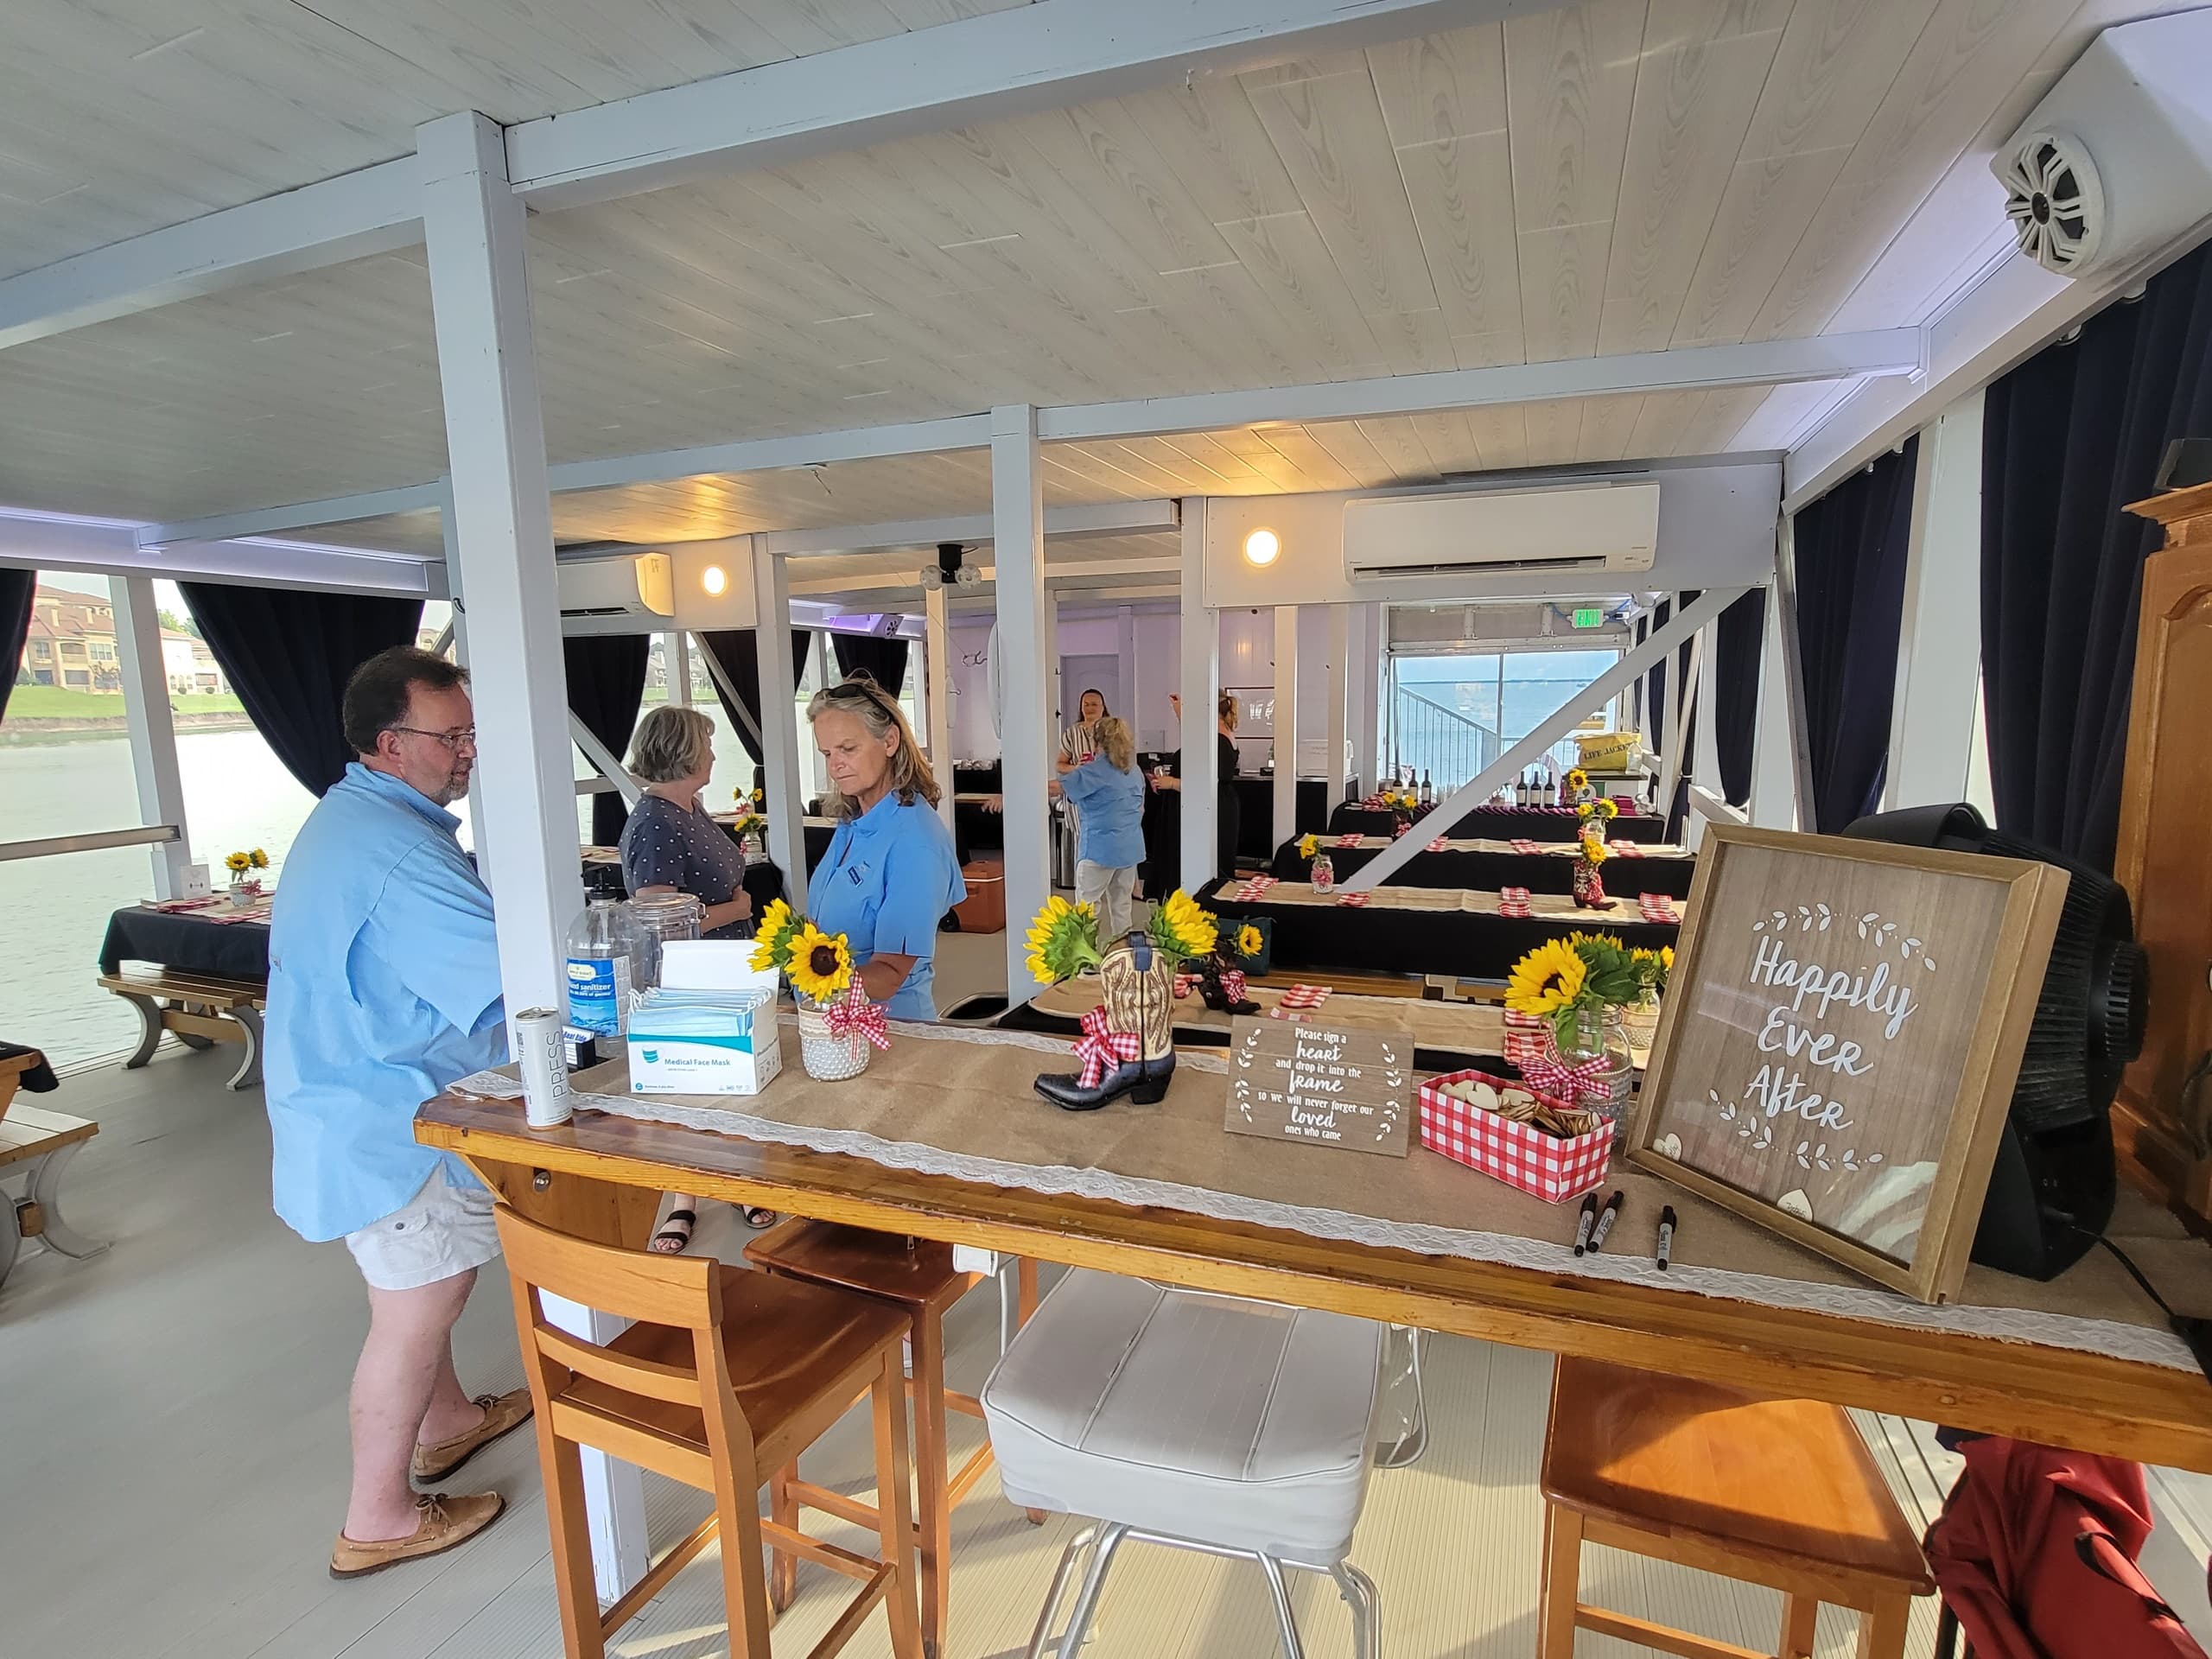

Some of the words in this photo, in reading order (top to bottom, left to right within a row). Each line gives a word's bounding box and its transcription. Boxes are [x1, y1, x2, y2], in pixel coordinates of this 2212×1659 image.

[1584, 749, 1602, 760] LIFE
[580, 982, 612, 991] sanitizer
[1750, 935, 1919, 1040] Happily
[1295, 1027, 1322, 1041] Please
[1324, 1031, 1339, 1045] sign
[1341, 1035, 1347, 1044] a
[1758, 1006, 1874, 1076] Ever
[1296, 1041, 1342, 1061] heart
[546, 1030, 567, 1098] PRESS
[1275, 1058, 1292, 1069] and
[1295, 1061, 1315, 1074] drop
[1317, 1064, 1326, 1073] it
[1328, 1065, 1345, 1076] into
[1348, 1065, 1362, 1078] the
[1288, 1070, 1344, 1094] frame
[1257, 1090, 1267, 1101] so
[1271, 1093, 1282, 1103] we
[1287, 1095, 1302, 1106] will
[1305, 1098, 1328, 1109] never
[1331, 1101, 1357, 1115] forget
[1360, 1106, 1374, 1116] our
[1744, 1064, 1854, 1130] After
[1291, 1105, 1337, 1128] loved
[1285, 1124, 1302, 1135] ones
[1304, 1127, 1319, 1138] who
[1322, 1129, 1342, 1141] came
